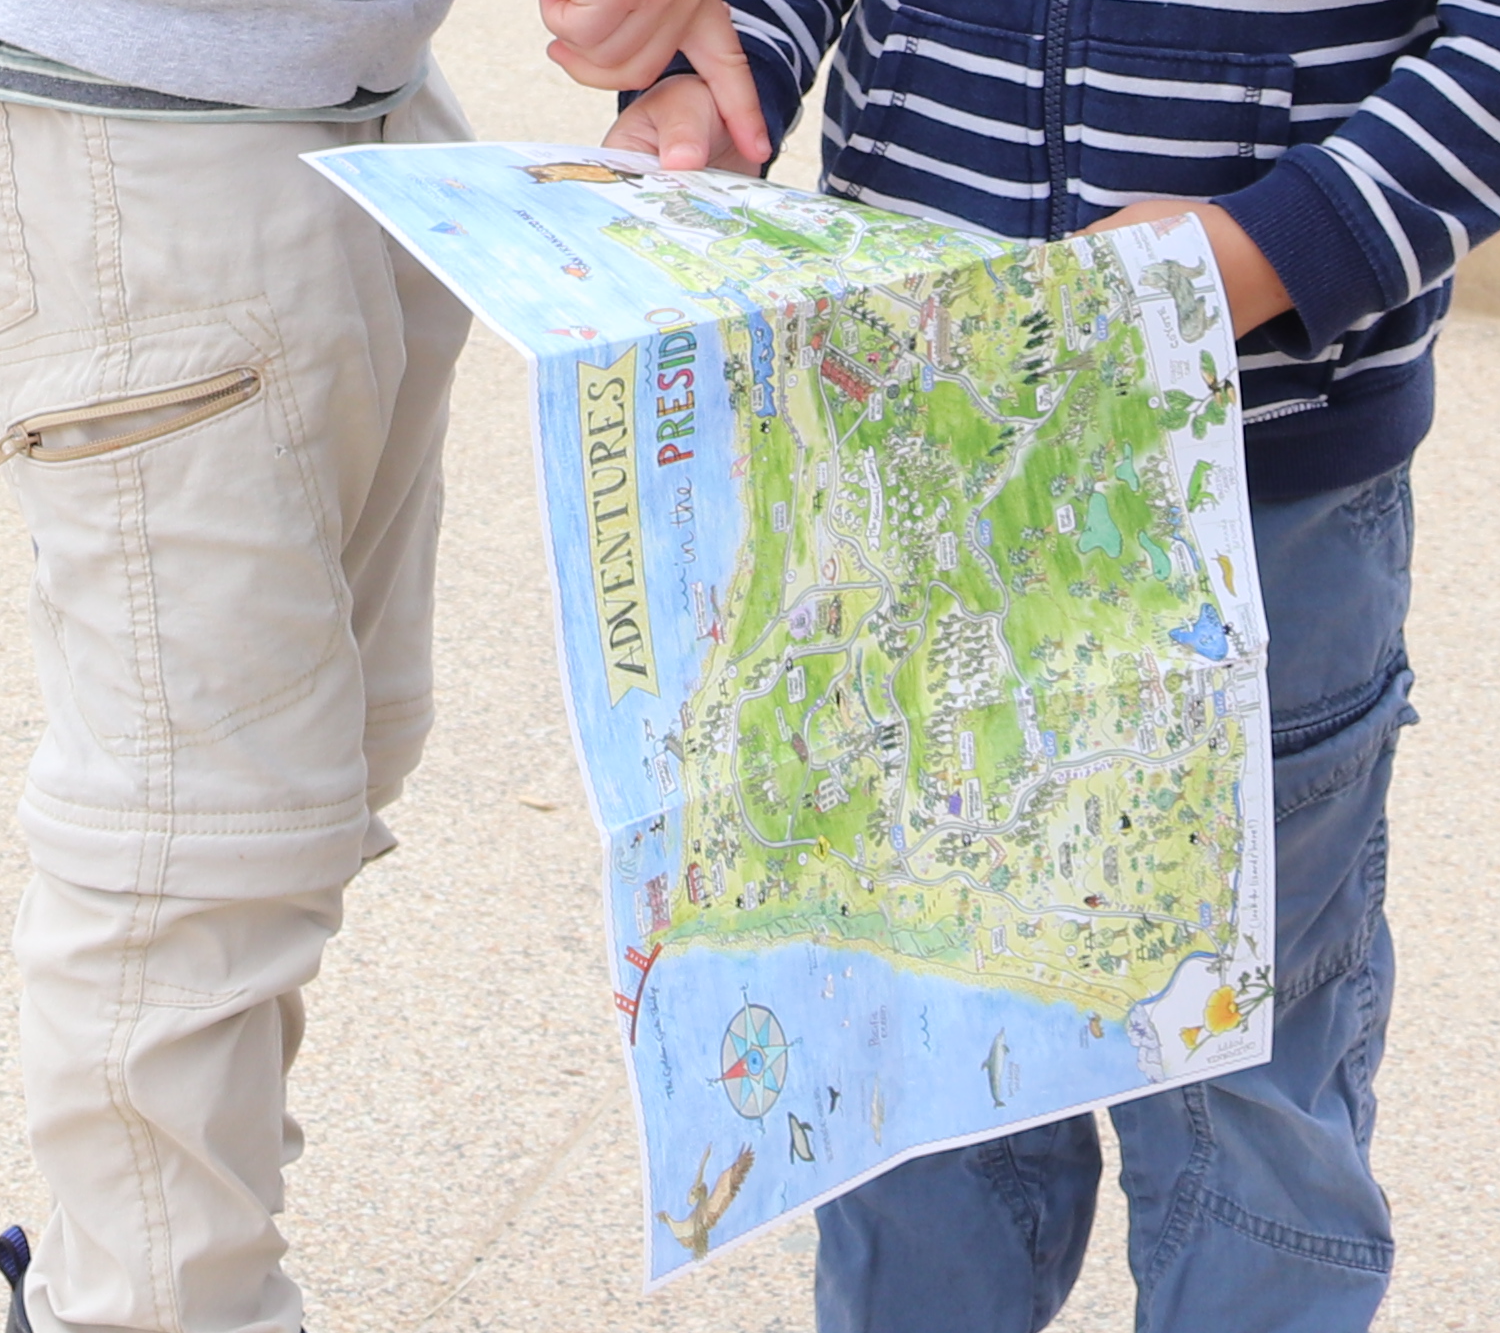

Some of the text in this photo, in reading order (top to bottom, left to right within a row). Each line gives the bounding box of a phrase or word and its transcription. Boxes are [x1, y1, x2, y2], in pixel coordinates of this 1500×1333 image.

[512, 209, 534, 221] BAY
[1157, 306, 1179, 349] COYOTE
[645, 307, 697, 566] in the PRESIDIO
[587, 375, 649, 678] ADVENTURES
[866, 457, 882, 536] The National Cemetery
[648, 986, 675, 1100] The Golden Gate Bridge
[868, 1011, 880, 1047] Pacific
